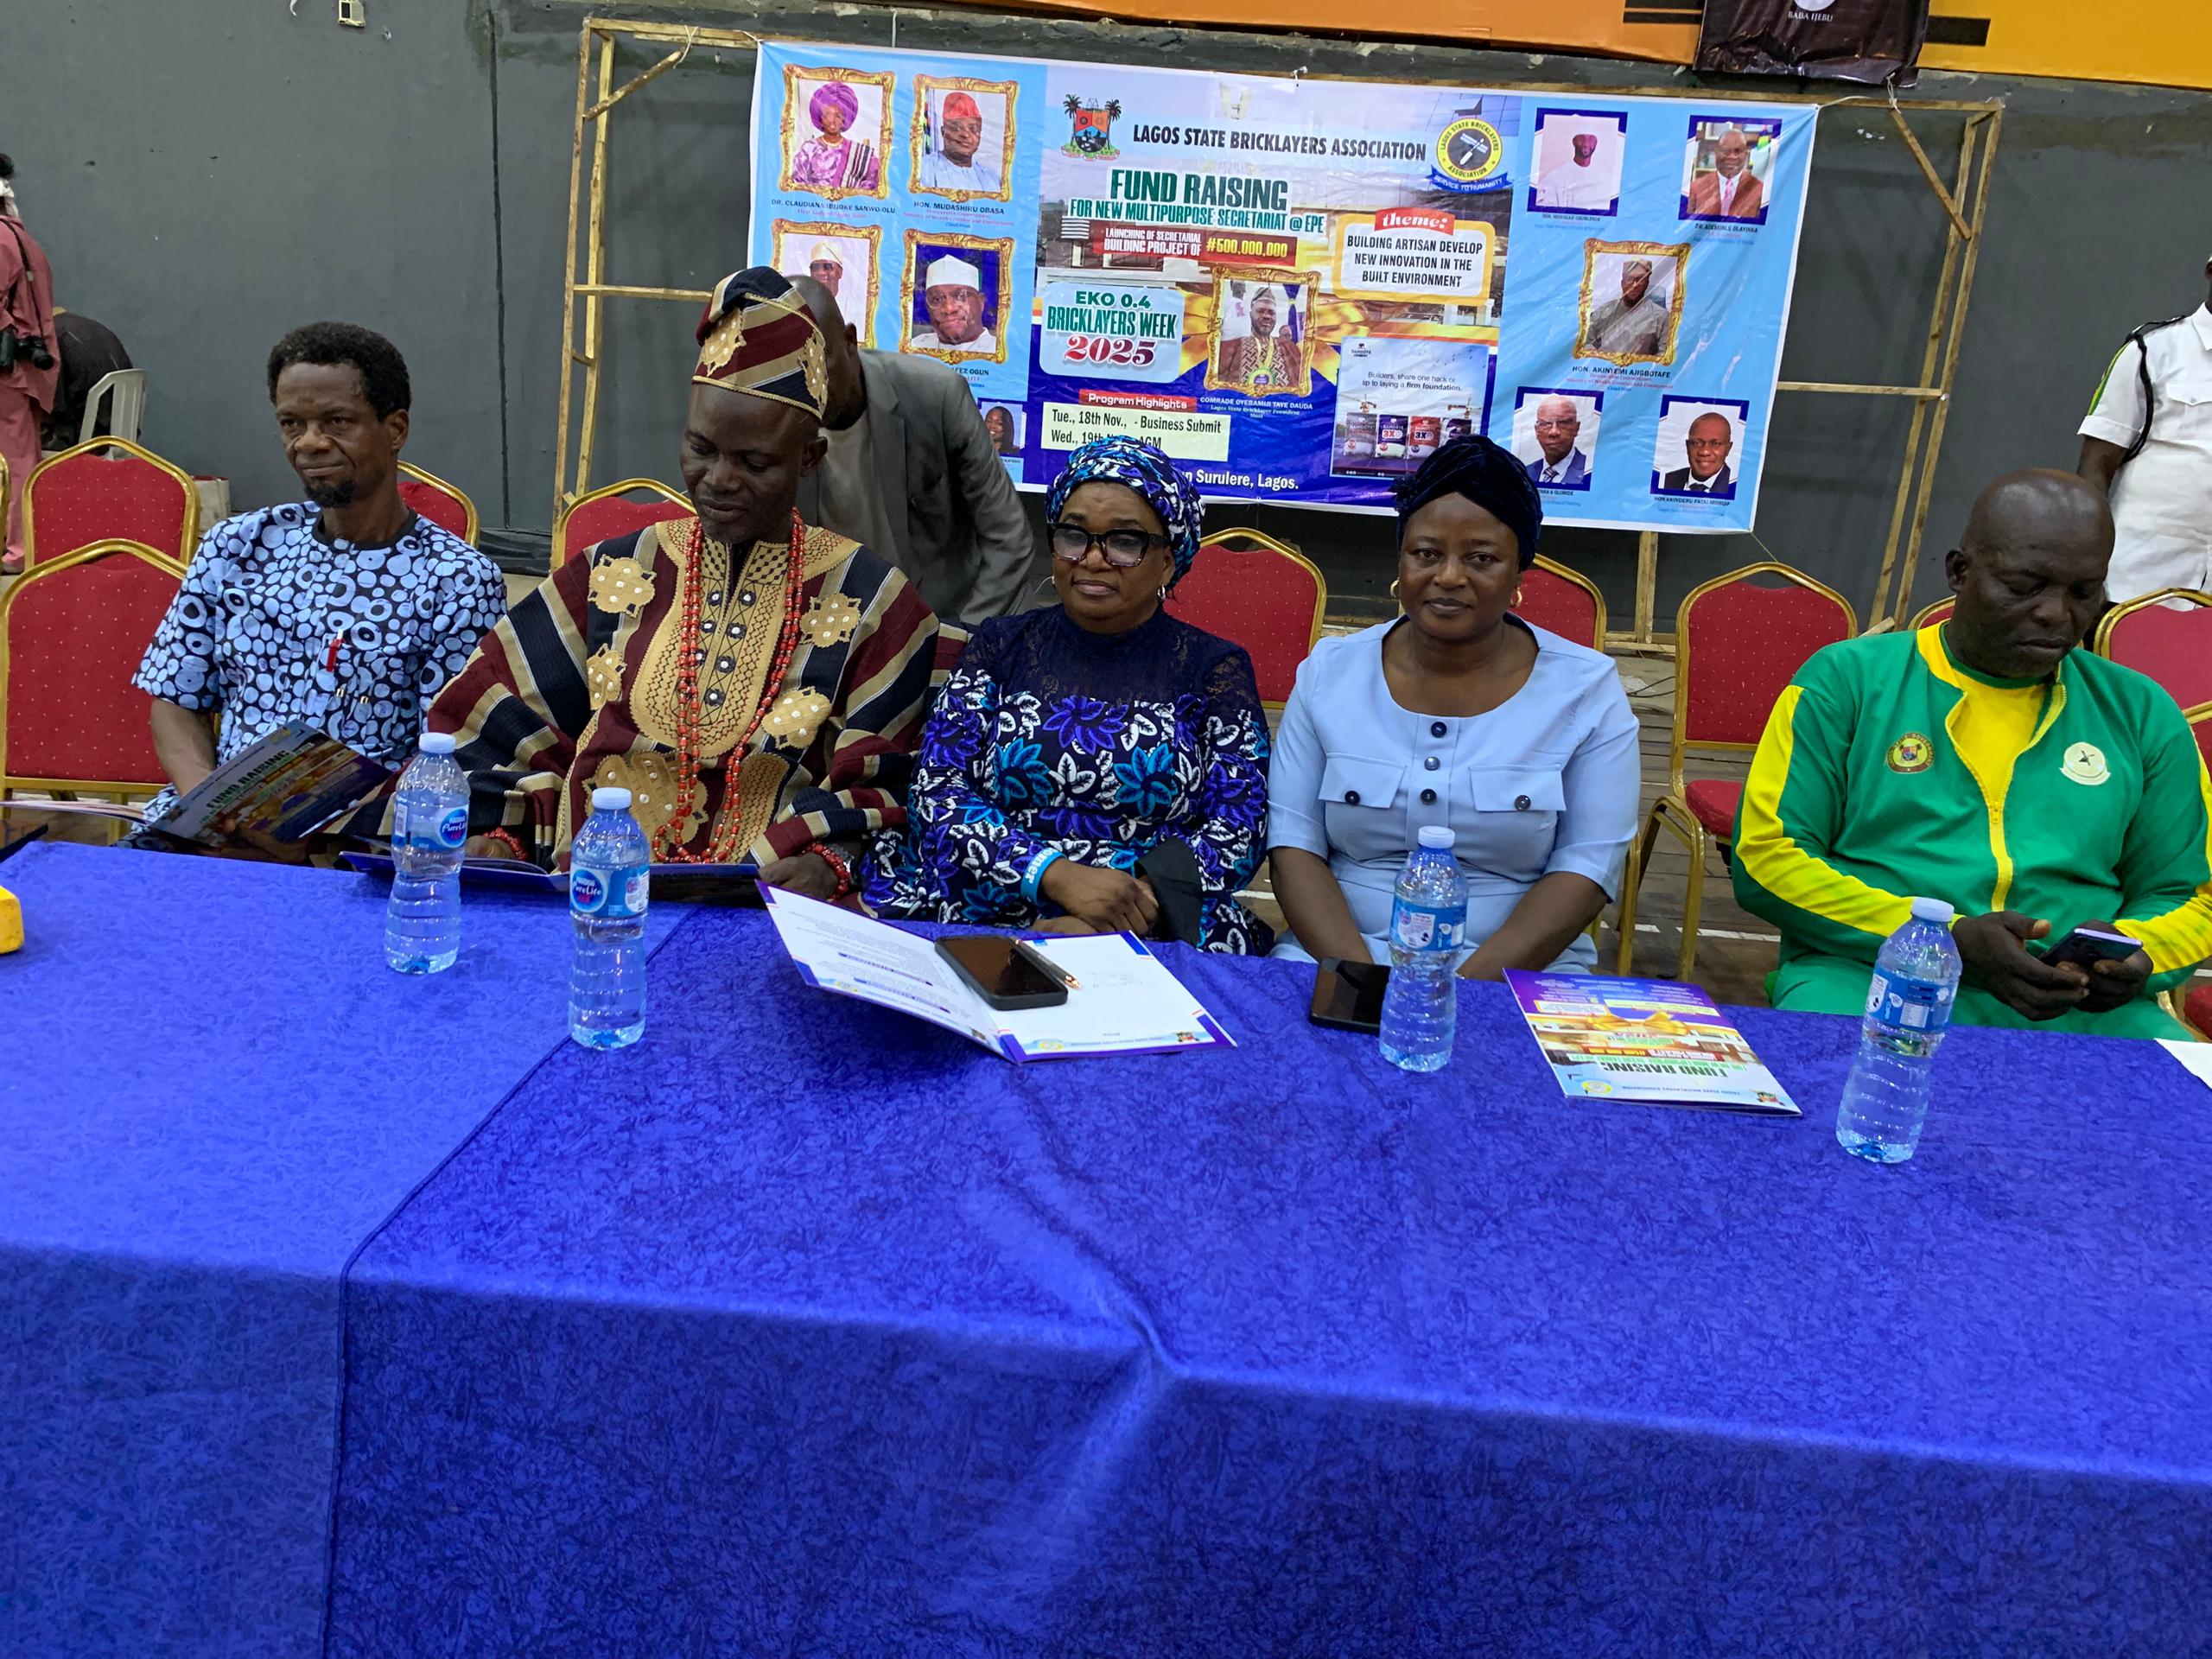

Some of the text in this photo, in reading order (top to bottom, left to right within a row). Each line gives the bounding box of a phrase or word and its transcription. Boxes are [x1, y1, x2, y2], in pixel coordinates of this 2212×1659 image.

[1788, 10, 1834, 22] BABA IJEBU
[1451, 121, 1469, 132] STATE
[1133, 124, 1427, 162] LAGOS STATE BRICKLAYERS ASSOCIATION
[1448, 166, 1488, 178] ASSOCIATION
[1110, 169, 1288, 211] FUND RAISING
[1433, 175, 1459, 188] SERVICE
[1471, 177, 1503, 190] HUMANITY
[1070, 199, 1325, 233] FOR NEW MULTIPURPOSE SECRETARIAT @ EPE
[1382, 213, 1448, 230] theme:
[1106, 228, 1146, 239] LAUNCHING
[1147, 230, 1155, 240] OF
[1104, 238, 1202, 257] BUILDING PROJECT OF
[1347, 235, 1483, 255] BUILDING ARTISAN DEVELOP
[1354, 252, 1472, 271] NEW INNOVATION IN THE
[1362, 270, 1462, 288] BUILT ENVIRONMENT
[1075, 290, 1152, 309] EKO 0.4
[1047, 306, 1177, 339] BRICKLAYERS WEEK
[1065, 334, 1156, 365] 2025
[1368, 372, 1395, 380] Builders,
[1422, 383, 1462, 391] foundation.
[1089, 392, 1187, 410] Program Highlights
[1052, 410, 1075, 424] Tue.,
[1078, 411, 1101, 425] 18th
[1103, 413, 1127, 429] Nov.,
[1141, 416, 1184, 431] Business
[1185, 418, 1222, 434] Submit
[1051, 429, 1078, 445] Wed.,
[1082, 432, 1103, 443] 19th
[1196, 468, 1254, 489] Surulere,
[1257, 474, 1299, 491] Lagos.
[1600, 1062, 1676, 1075] RAISING
